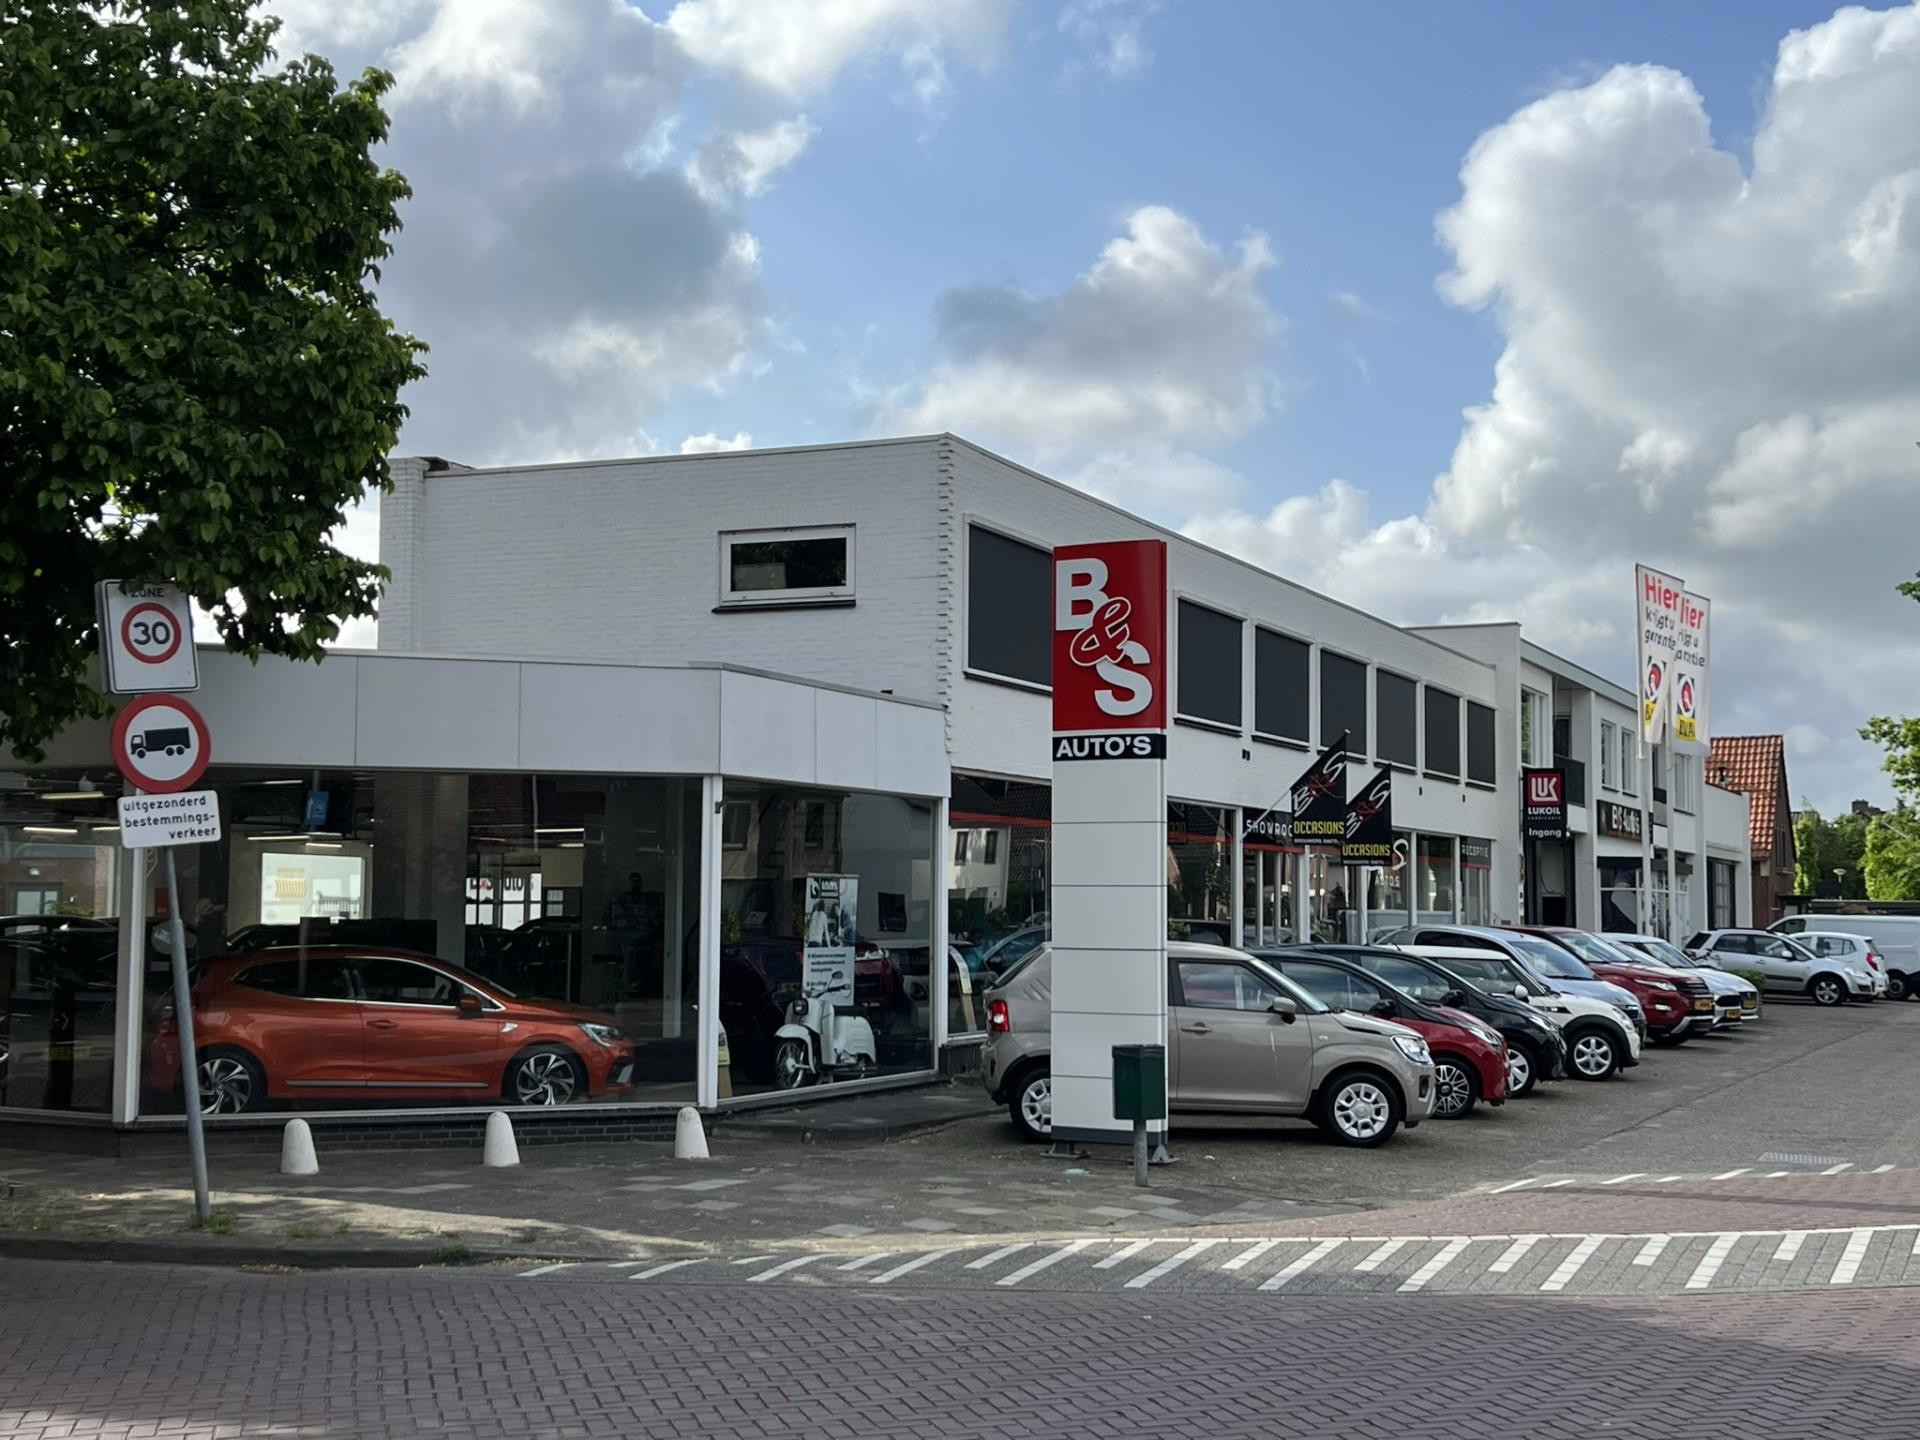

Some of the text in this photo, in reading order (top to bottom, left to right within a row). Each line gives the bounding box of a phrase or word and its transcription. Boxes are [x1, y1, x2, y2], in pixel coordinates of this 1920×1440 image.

[1645, 574, 1679, 611] Hier
[1680, 597, 1705, 630] ier
[133, 621, 171, 645] 30
[1056, 736, 1152, 759] AUTO'S
[123, 795, 207, 812] uitgezonderd
[1527, 806, 1561, 815] LUKOIL
[124, 813, 215, 829] bestemmings-
[1293, 820, 1345, 835] OCCASIONS
[168, 825, 216, 840] verkeer
[1528, 828, 1562, 838] Ingang
[1342, 843, 1391, 857] OCCASIONS
